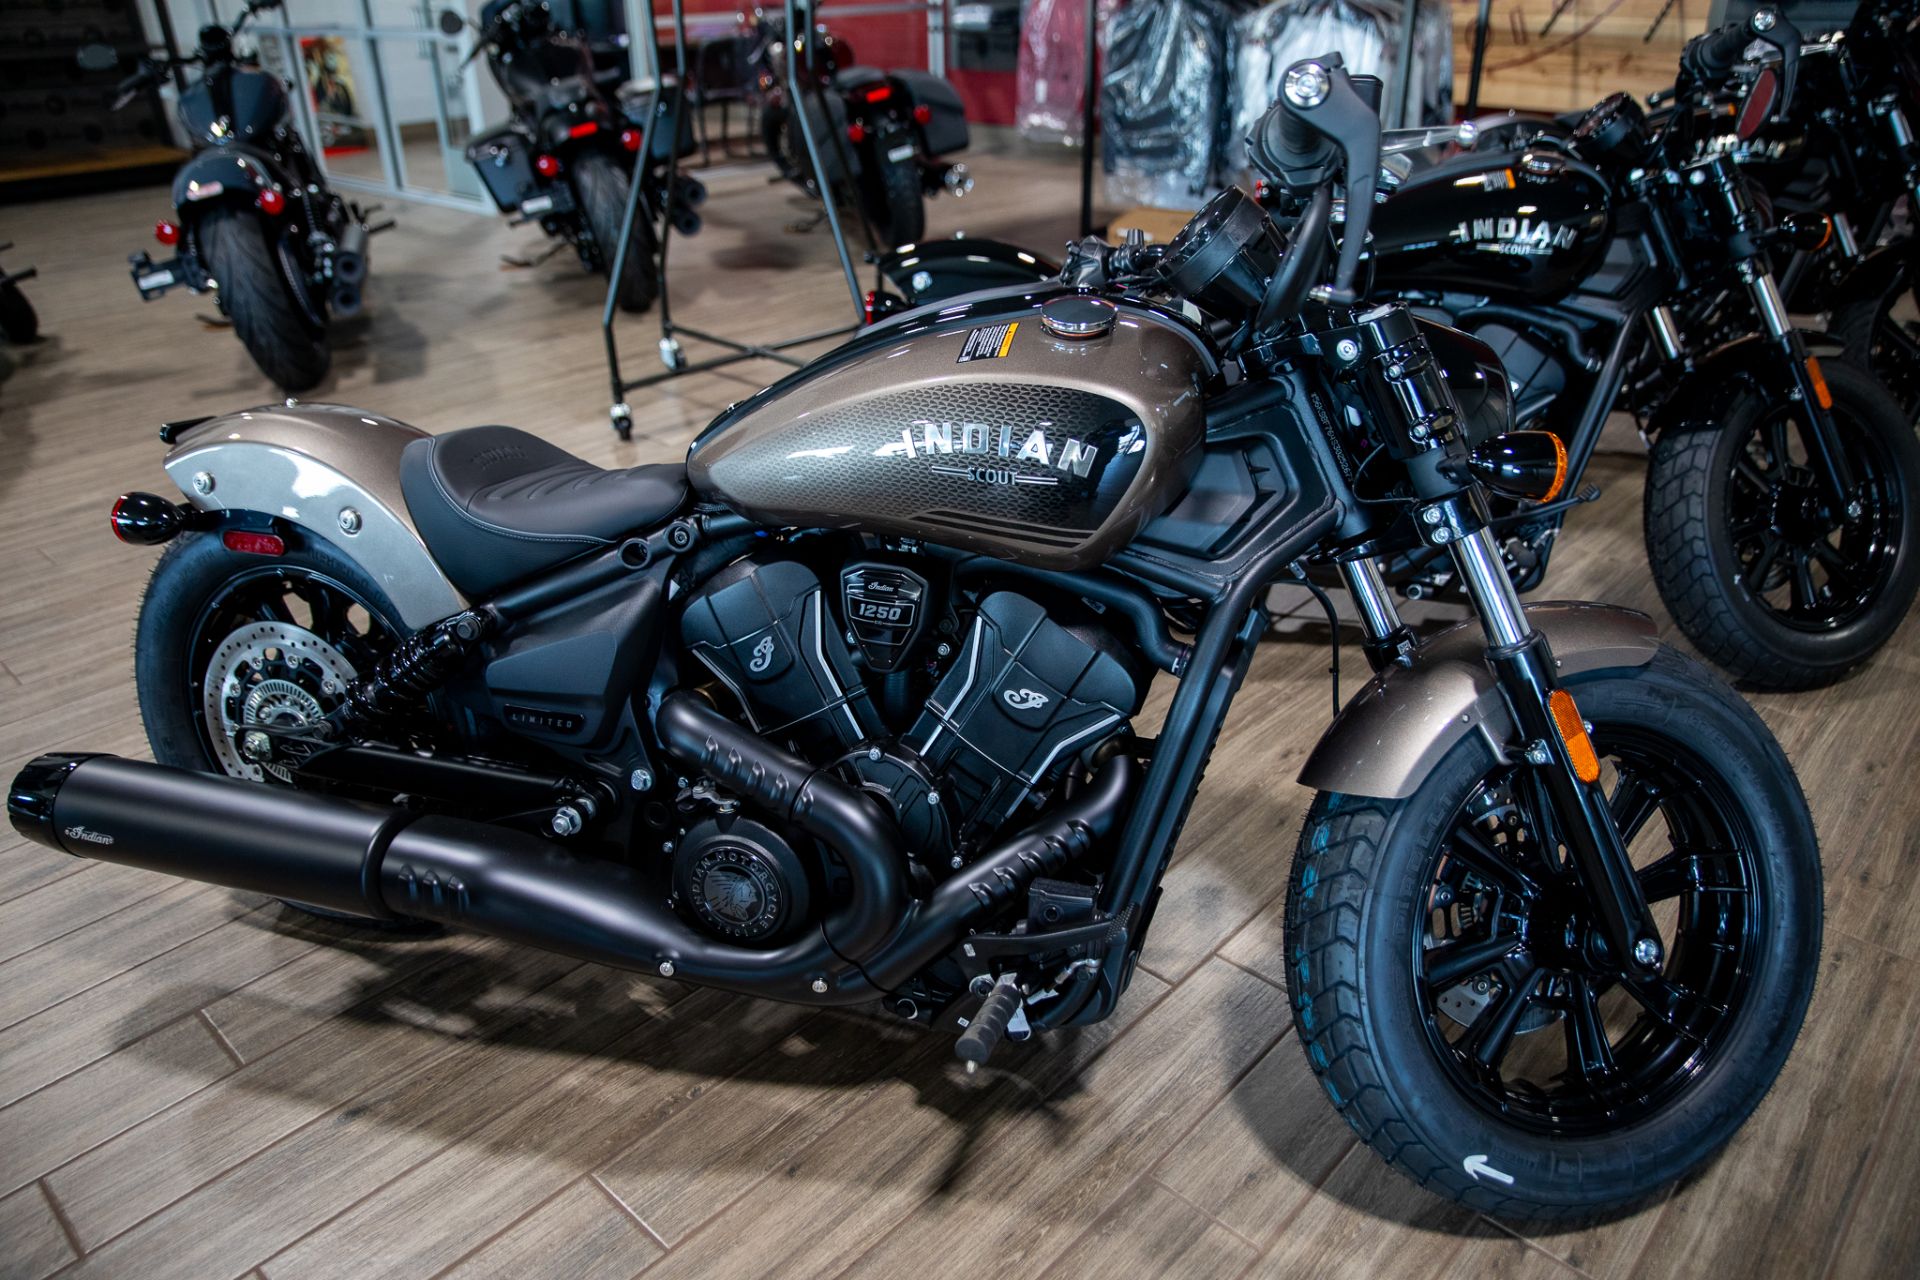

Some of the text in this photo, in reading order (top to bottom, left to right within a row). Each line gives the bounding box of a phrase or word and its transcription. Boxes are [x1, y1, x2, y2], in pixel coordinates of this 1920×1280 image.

[1458, 216, 1578, 249] INDIAN
[1499, 242, 1531, 255] SCOUT
[898, 421, 1098, 478] INDIAN
[967, 467, 1019, 486] SCOUT
[868, 581, 895, 592] Indian
[859, 603, 901, 621] 1250
[512, 713, 572, 728] LIMITED
[69, 826, 113, 845] Indian
[692, 850, 778, 929] INDIAN MOTORCYCLE
